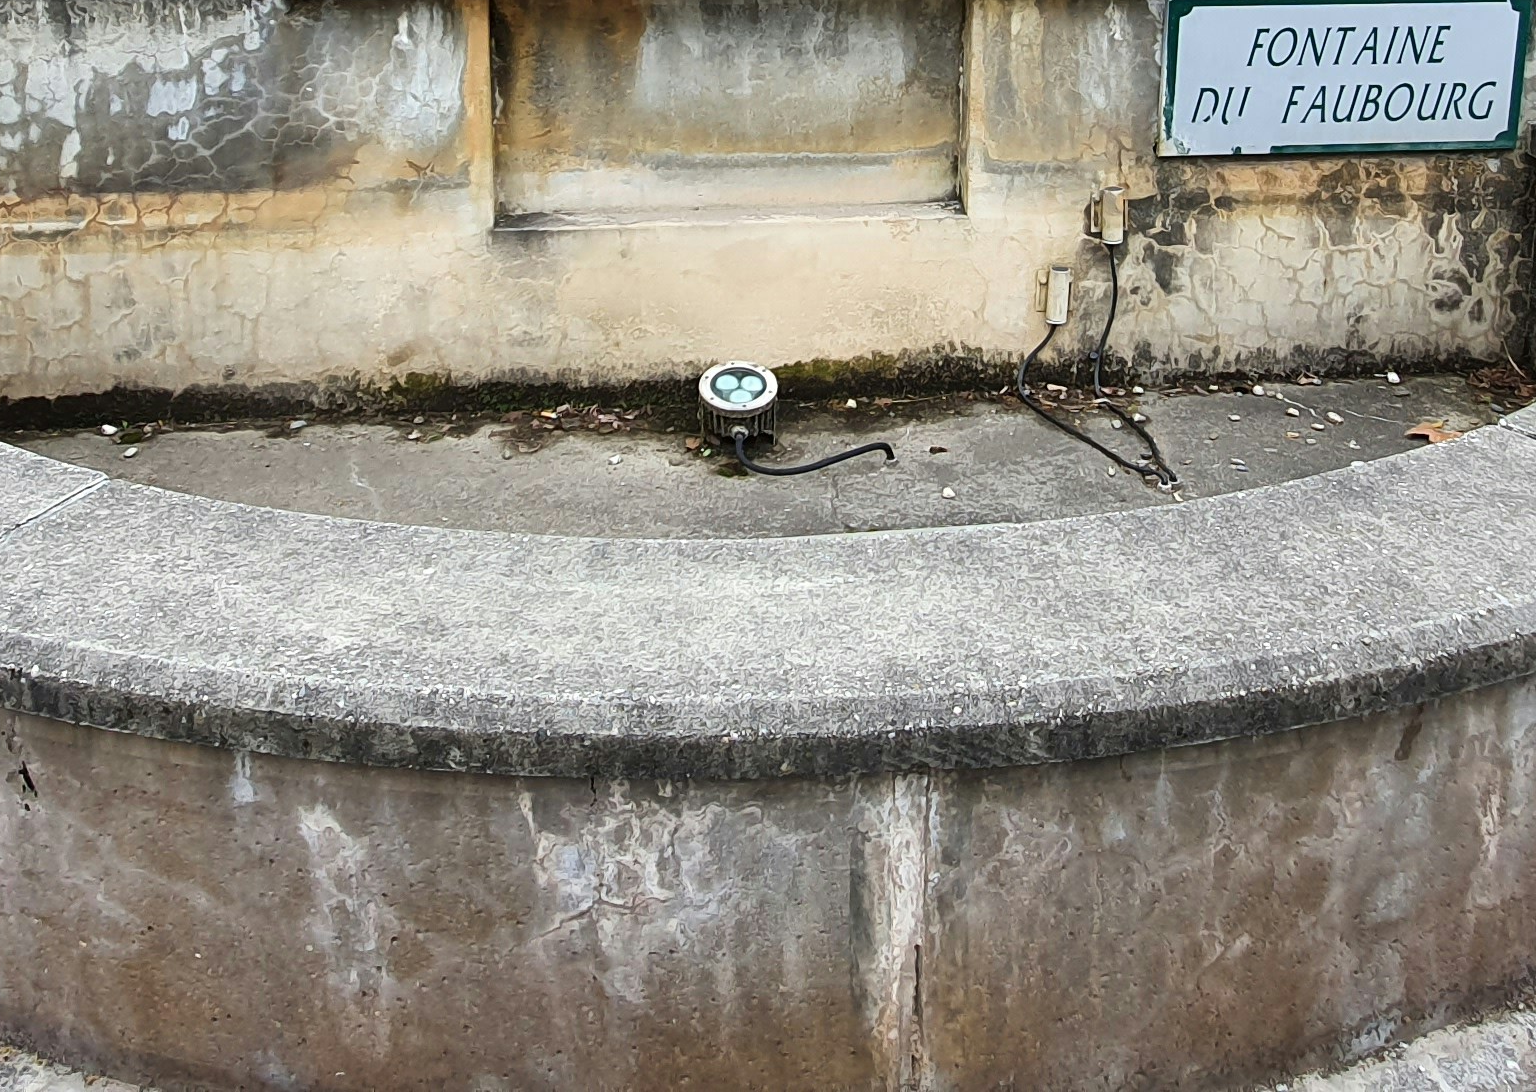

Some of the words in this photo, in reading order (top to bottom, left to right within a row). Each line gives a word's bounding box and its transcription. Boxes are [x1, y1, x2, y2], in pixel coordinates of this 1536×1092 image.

[1246, 25, 1452, 67] FONTAINE
[1191, 85, 1252, 126] DU
[1281, 81, 1498, 124] FAUBOURG
